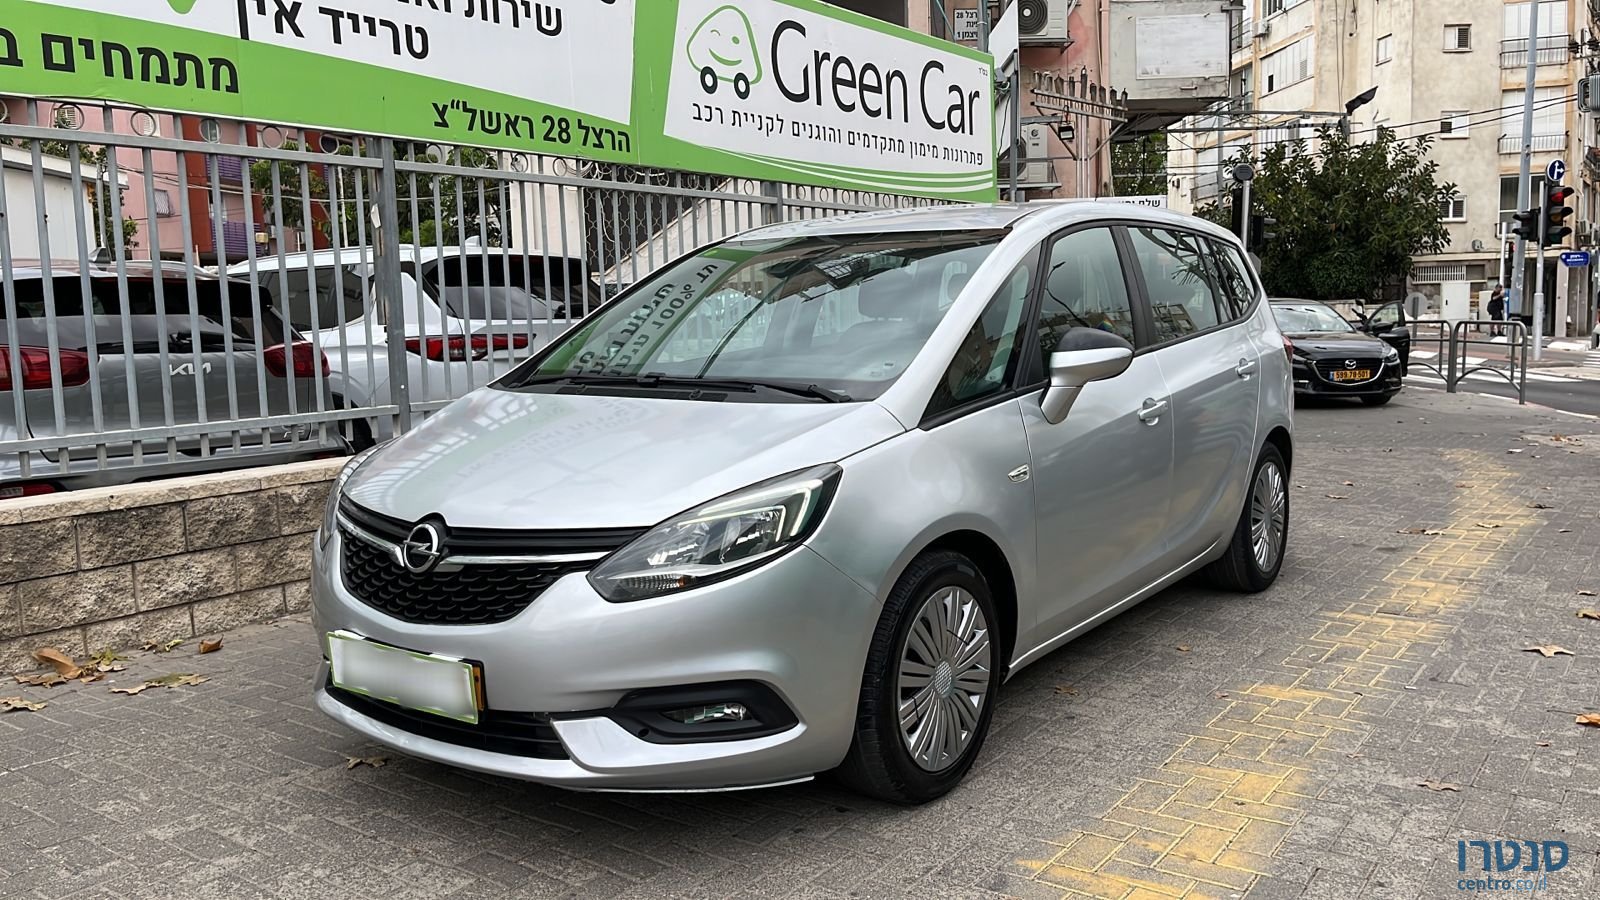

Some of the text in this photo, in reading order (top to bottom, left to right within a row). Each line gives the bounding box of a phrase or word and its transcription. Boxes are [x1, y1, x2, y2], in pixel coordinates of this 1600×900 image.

[237, 0, 429, 60] טרייד אין
[956, 11, 964, 19] 28
[40, 32, 240, 94] מתמחים
[770, 19, 980, 136] Green Car
[541, 114, 572, 144] 28
[577, 118, 631, 153] הרצל
[692, 102, 984, 166] פתרונות מימון מתקדמים והוגנים לקניית רכב
